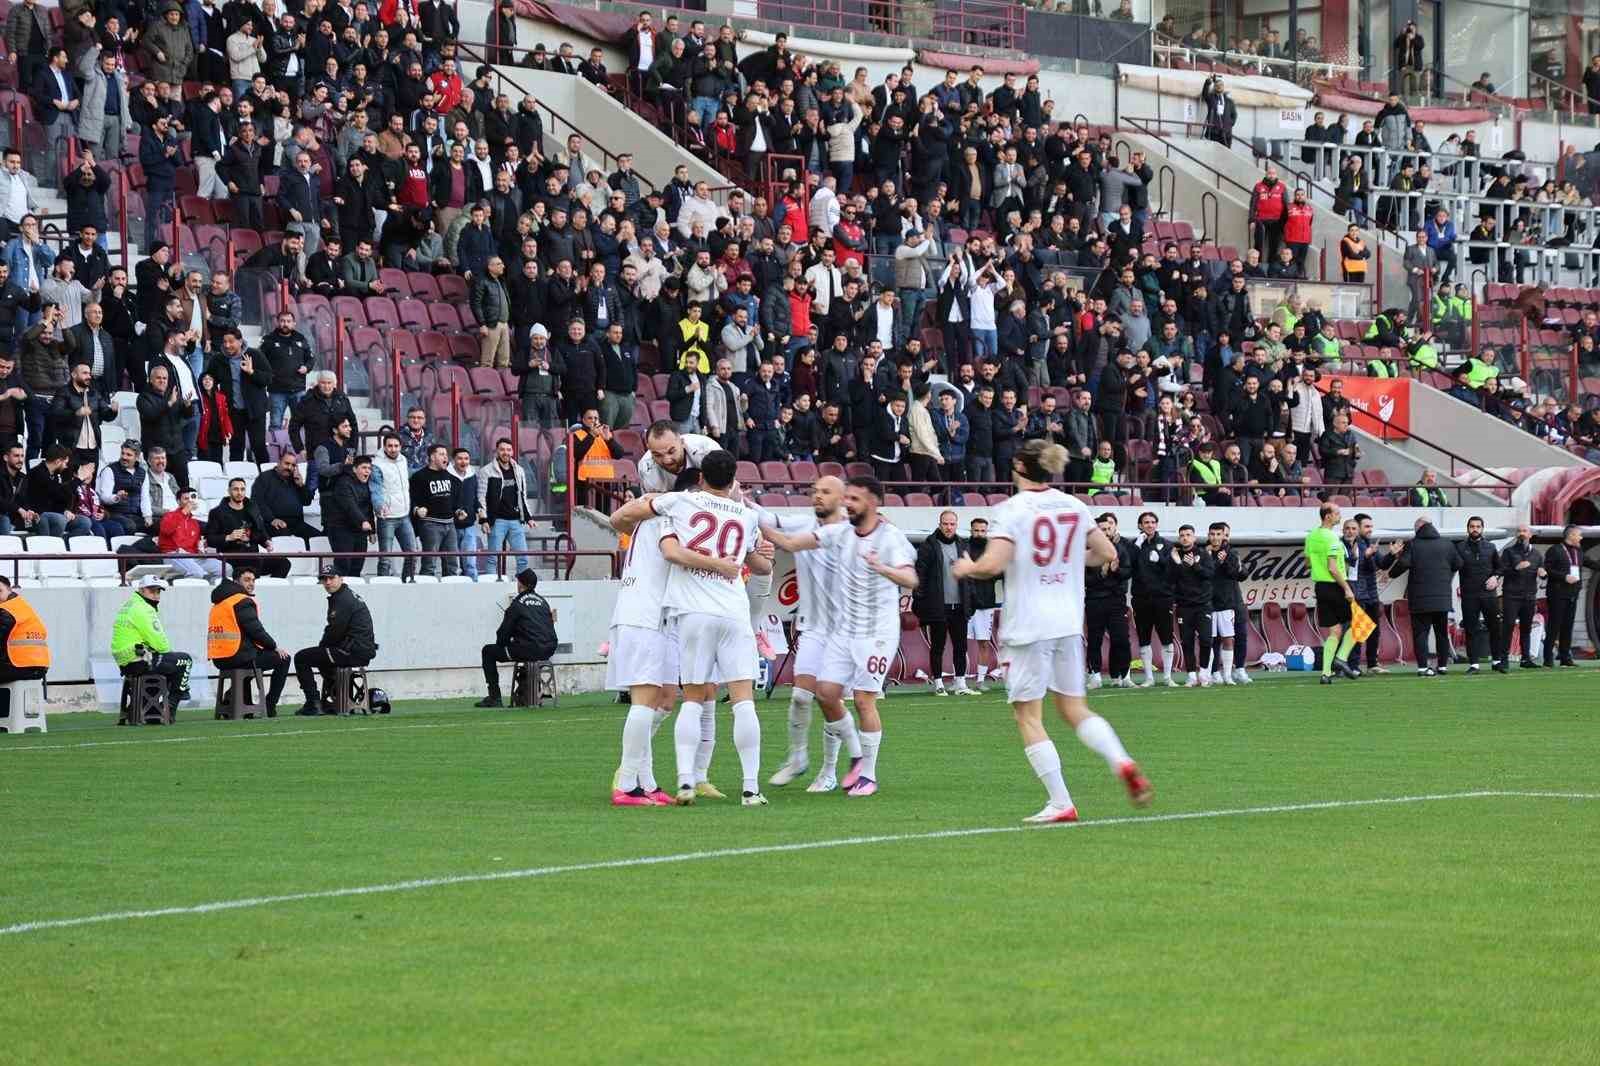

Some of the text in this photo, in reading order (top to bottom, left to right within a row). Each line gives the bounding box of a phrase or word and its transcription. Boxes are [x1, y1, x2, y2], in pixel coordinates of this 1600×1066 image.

[687, 511, 744, 559] 20
[1032, 512, 1080, 567] 97
[866, 655, 888, 676] 66
